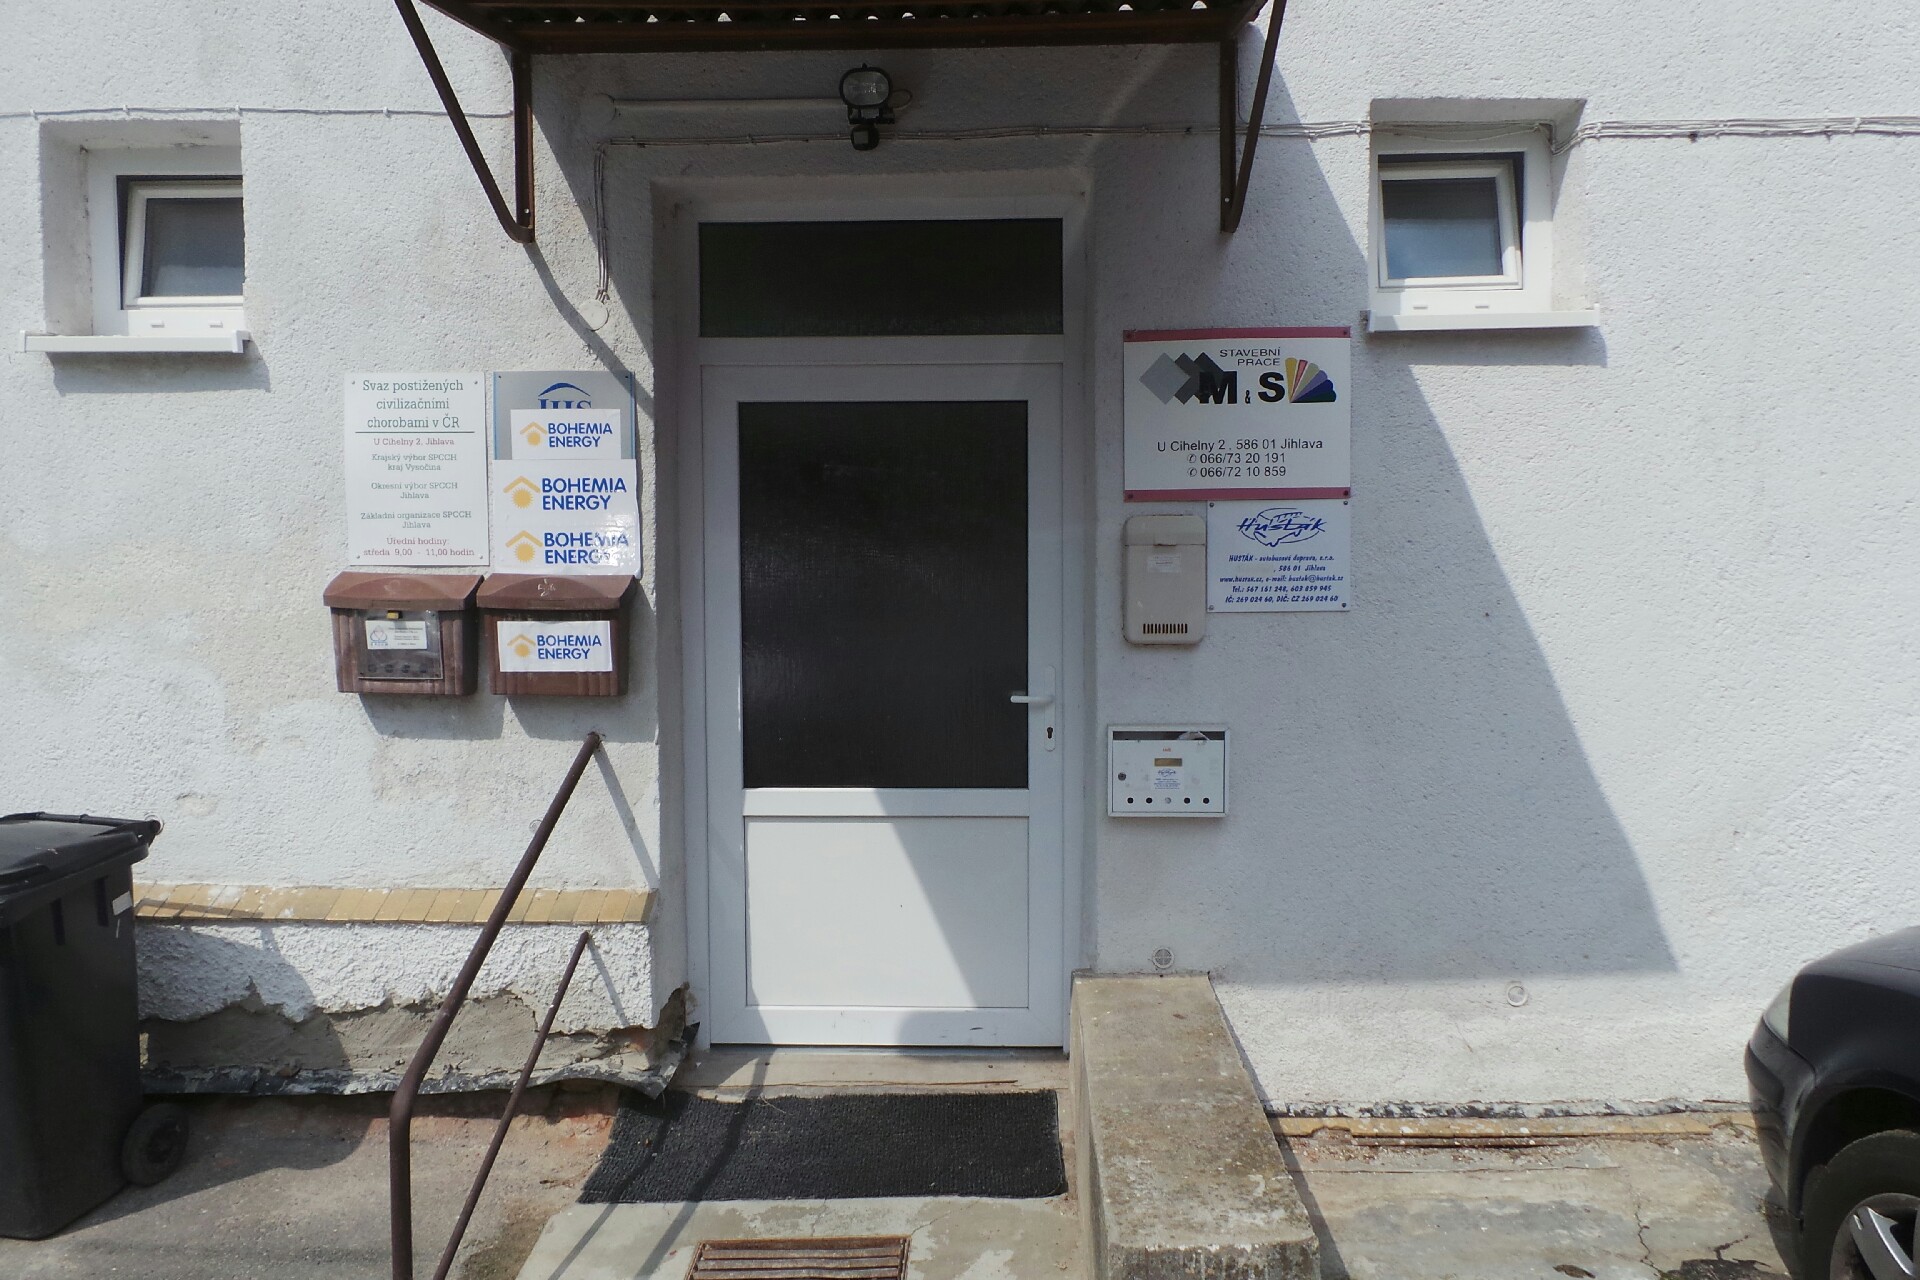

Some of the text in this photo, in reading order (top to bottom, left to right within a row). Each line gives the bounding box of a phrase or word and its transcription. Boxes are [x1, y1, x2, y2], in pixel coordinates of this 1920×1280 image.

[1220, 346, 1281, 357] STAVEBNÍ
[363, 379, 464, 393] Svaz postižených
[1199, 371, 1285, 404] M & S
[376, 398, 450, 410] civilizačními
[367, 414, 460, 428] chorobami v ČR
[548, 423, 612, 435] BOHEMIA
[374, 438, 380, 446] U
[382, 438, 414, 447] Cihelny
[549, 436, 601, 448] ENERGY
[1157, 442, 1166, 452] U
[1170, 440, 1214, 454] Cihelny
[1236, 439, 1258, 450] 586
[1262, 439, 1276, 450] 01
[1280, 438, 1323, 449] Jihlava
[372, 454, 401, 462] Krajský
[403, 454, 426, 462] výbor
[1200, 452, 1286, 464] 066/73 20 191
[388, 463, 441, 472] kraj Vysočina
[1200, 466, 1286, 478] 066/72 10 859
[371, 482, 402, 490] Okresní
[404, 482, 427, 490] výbor
[542, 477, 627, 493] BOHEMIA
[542, 495, 611, 510] ENERGY
[397, 512, 440, 521] organizace
[1229, 554, 1254, 562] HUSTÁK
[1304, 564, 1326, 572] Jihlava
[1225, 595, 1234, 603] IČ:
[1276, 594, 1289, 602] DIČ:
[537, 634, 602, 647] BOHEMIA
[538, 648, 590, 660] ENERGY
